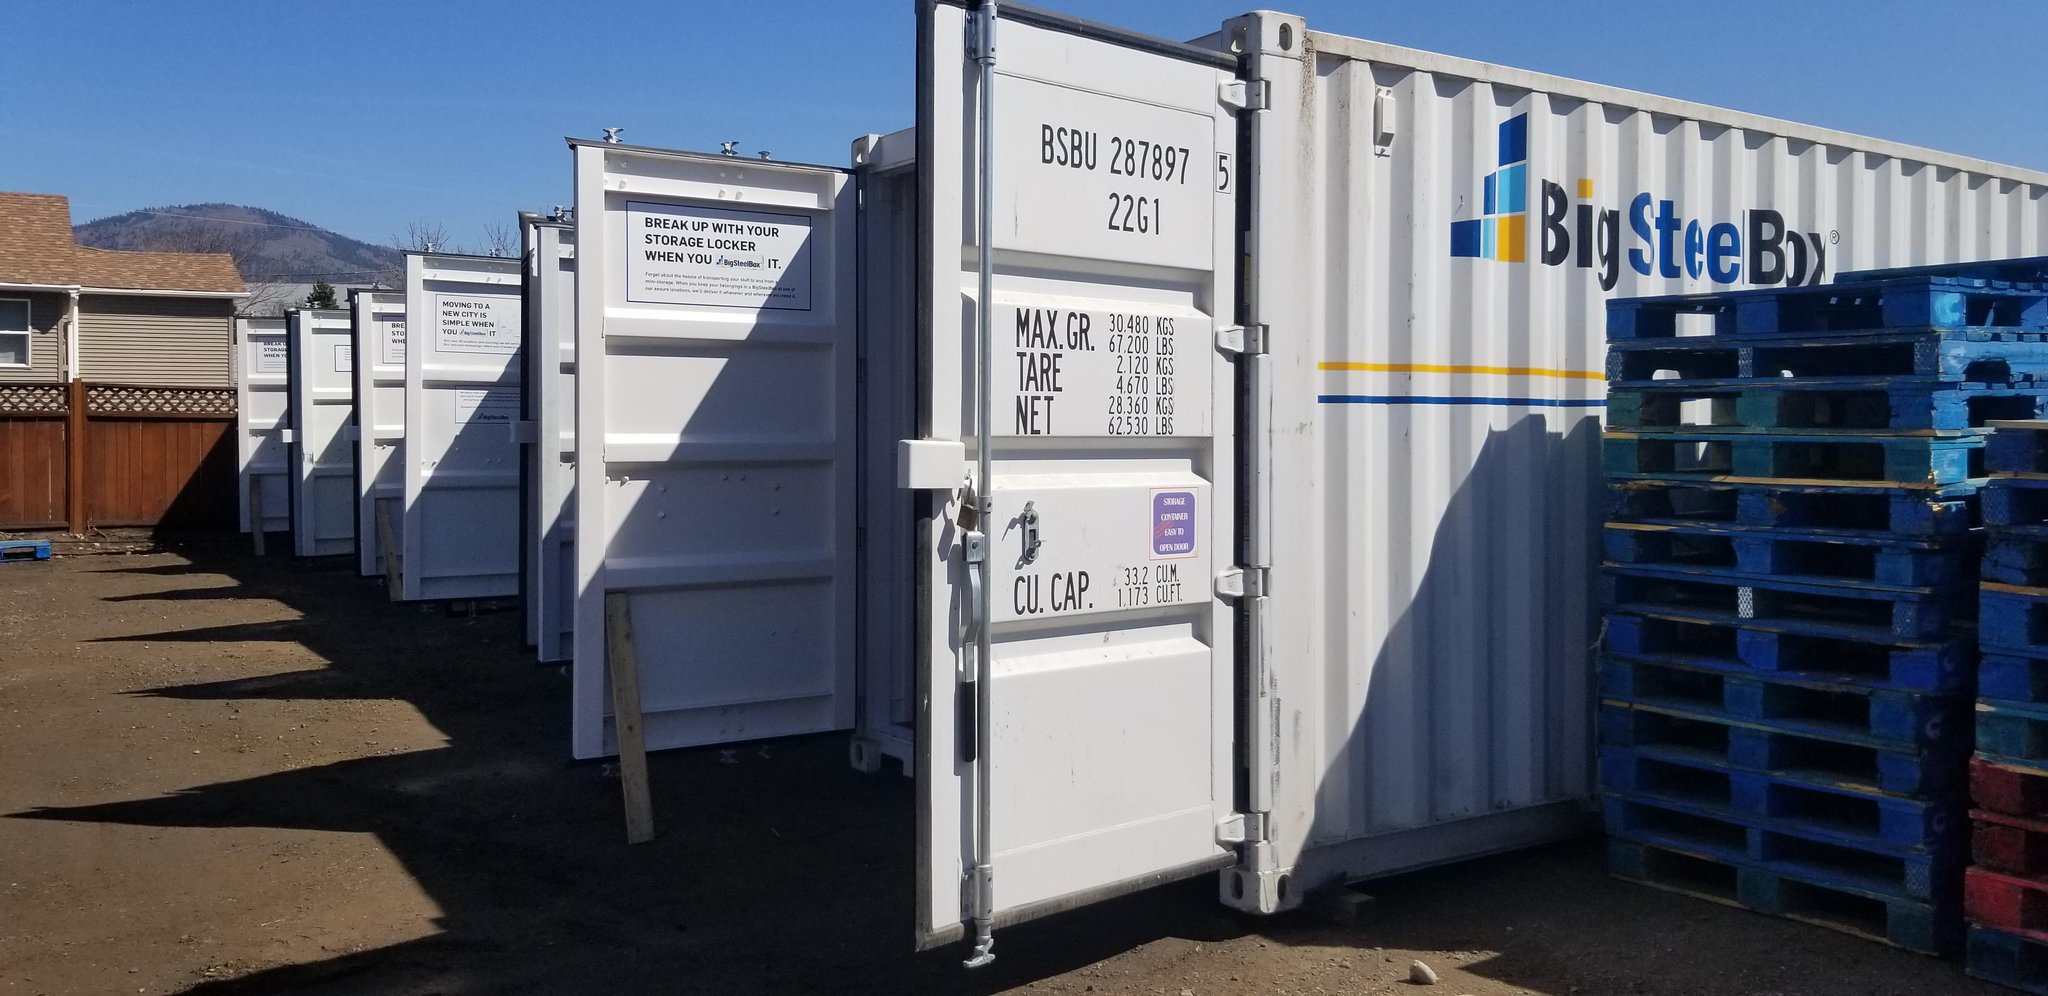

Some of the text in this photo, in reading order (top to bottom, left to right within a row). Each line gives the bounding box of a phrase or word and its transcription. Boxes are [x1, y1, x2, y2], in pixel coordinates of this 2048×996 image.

[1041, 123, 1229, 190] BSBU 287897 5
[1108, 192, 1160, 235] 22G1
[645, 217, 779, 238] BREAK UP WITH YOUR
[645, 233, 756, 252] STORAGE LOCKER
[645, 250, 684, 263] WHEN
[687, 253, 712, 265] YOU
[768, 258, 781, 269] IT.
[442, 301, 472, 309] MOVING
[442, 319, 470, 327] SIMPLE
[1156, 316, 1174, 336] KGS
[1156, 337, 1174, 355] LBS
[1016, 352, 1063, 392] TARE
[1156, 356, 1174, 375] KGS
[1156, 376, 1174, 395] LBS
[1016, 395, 1054, 435] NET
[1156, 396, 1174, 416] KGS
[1155, 416, 1174, 435] LBS
[1163, 497, 1186, 506] STORAGE
[1160, 512, 1188, 521] CONTAINER
[1177, 528, 1184, 536] TO
[1159, 543, 1188, 552] OPEN DOOR
[1014, 574, 1044, 615] CU.
[1051, 570, 1093, 612] CAP.
[1124, 566, 1148, 586] 33.2
